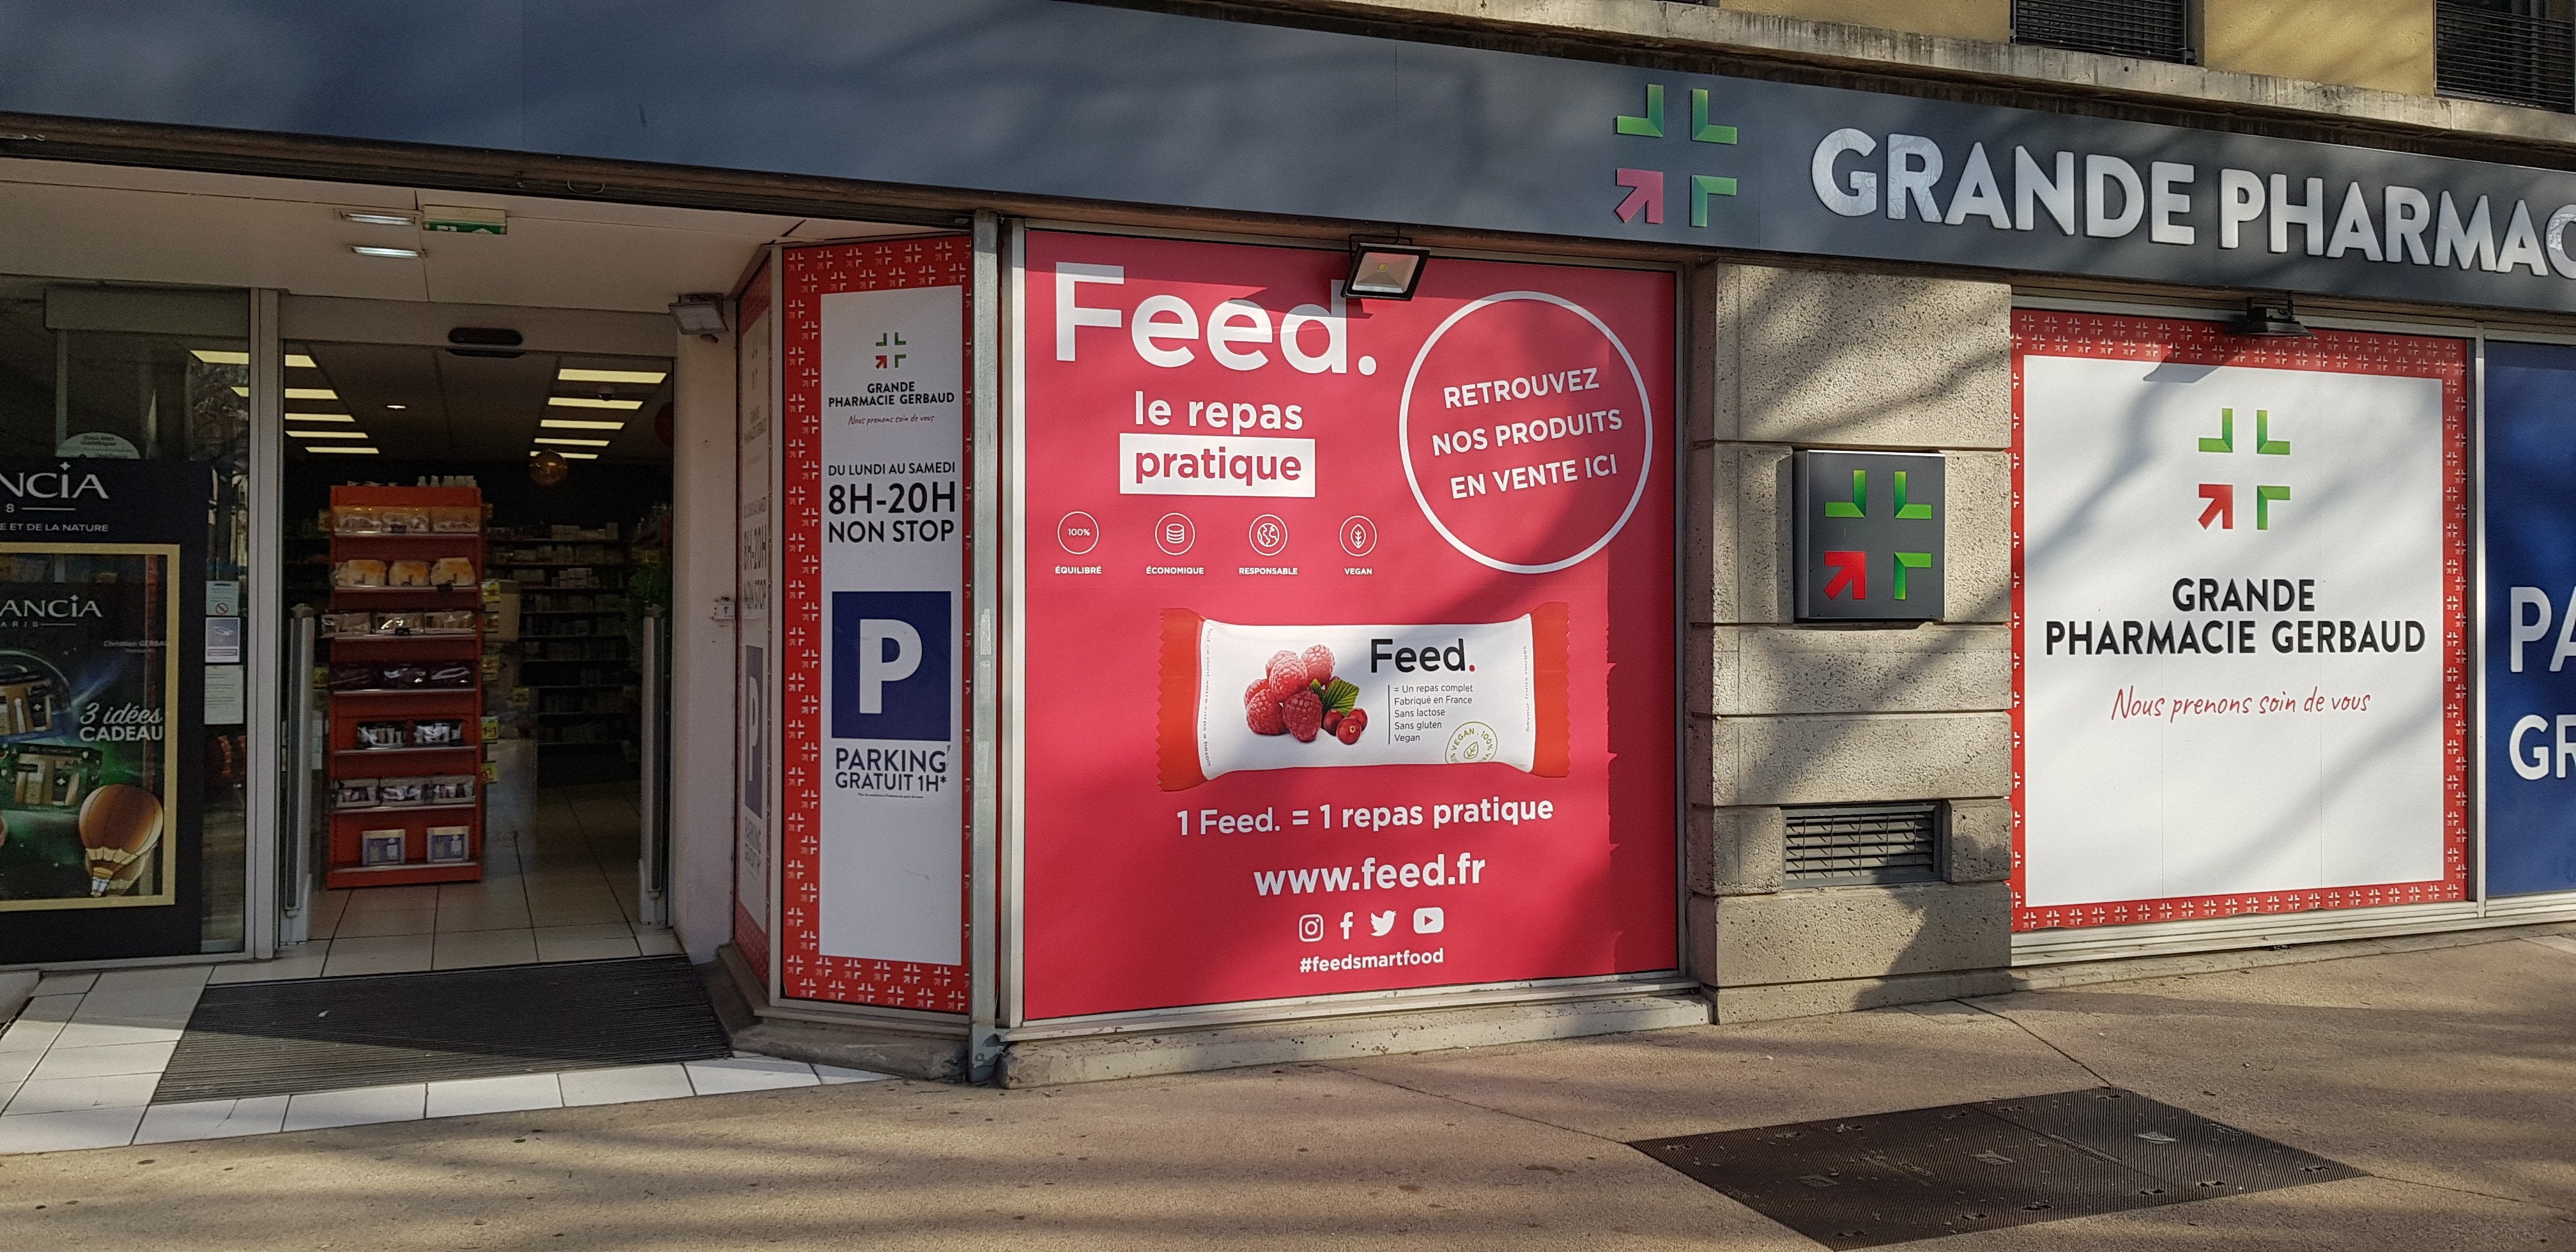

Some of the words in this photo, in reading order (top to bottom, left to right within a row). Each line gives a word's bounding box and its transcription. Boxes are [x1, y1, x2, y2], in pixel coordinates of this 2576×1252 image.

[1812, 128, 2194, 244] GRANDE
[1055, 262, 1377, 376] Feed.
[868, 381, 914, 393] GRANDE
[1444, 368, 1598, 408] RETROUVEZ
[829, 395, 894, 407] PHARMACIE
[900, 392, 954, 404] GERBAUD
[848, 415, 865, 425] Nous
[1136, 391, 1171, 425] le
[1188, 401, 1303, 434] repas
[1432, 429, 1487, 455] NOS
[1496, 409, 1621, 447] PRODUITS
[829, 465, 845, 475] DU
[850, 464, 885, 475] LUNDI
[889, 463, 905, 474] AU
[909, 462, 954, 473] SAMEDI
[1137, 447, 1301, 486] pratique
[1451, 474, 1485, 498] EN
[1492, 460, 1577, 491] VENTE
[1585, 454, 1616, 478] ICI
[829, 482, 954, 514] 8H-20H
[63, 524, 109, 532] NATURE
[829, 521, 884, 542] NON
[893, 520, 954, 542] STOP
[1055, 565, 1101, 574] ÉQUILIBRÉ
[2173, 578, 2314, 611] GRANDE
[2047, 620, 2255, 655] PHARMACIE
[2273, 620, 2425, 653] GERBAUD
[860, 619, 922, 714] P
[1371, 639, 1475, 673] Feed.
[1441, 684, 1473, 692] complet
[1394, 696, 1431, 706] Fabriqué
[1446, 695, 1472, 704] France
[2112, 685, 2165, 720] Nous
[2170, 698, 2252, 723] prenons
[2259, 691, 2296, 714] soin
[2304, 686, 2324, 712] de
[2332, 694, 2370, 711] vous
[79, 703, 100, 724] 3
[103, 703, 163, 725] idées
[1417, 708, 1445, 717] lactose
[79, 726, 164, 742] CADEAU
[1417, 721, 1441, 730] gluten
[1395, 734, 1420, 742] Vegan
[1451, 728, 1475, 750] VEGAN
[1481, 731, 1494, 750] 100%
[836, 748, 946, 774] PARKING
[836, 772, 913, 790] GRATUIT
[1177, 811, 1187, 835] 1
[1201, 807, 1280, 834] Feed.
[1293, 811, 1308, 825] =
[1320, 804, 1330, 828] 1
[1343, 806, 1423, 831] repas
[1434, 797, 1553, 828] pratique
[1254, 853, 1485, 896] www.feed.fr
[1300, 948, 1443, 972] #feedsmartfood
